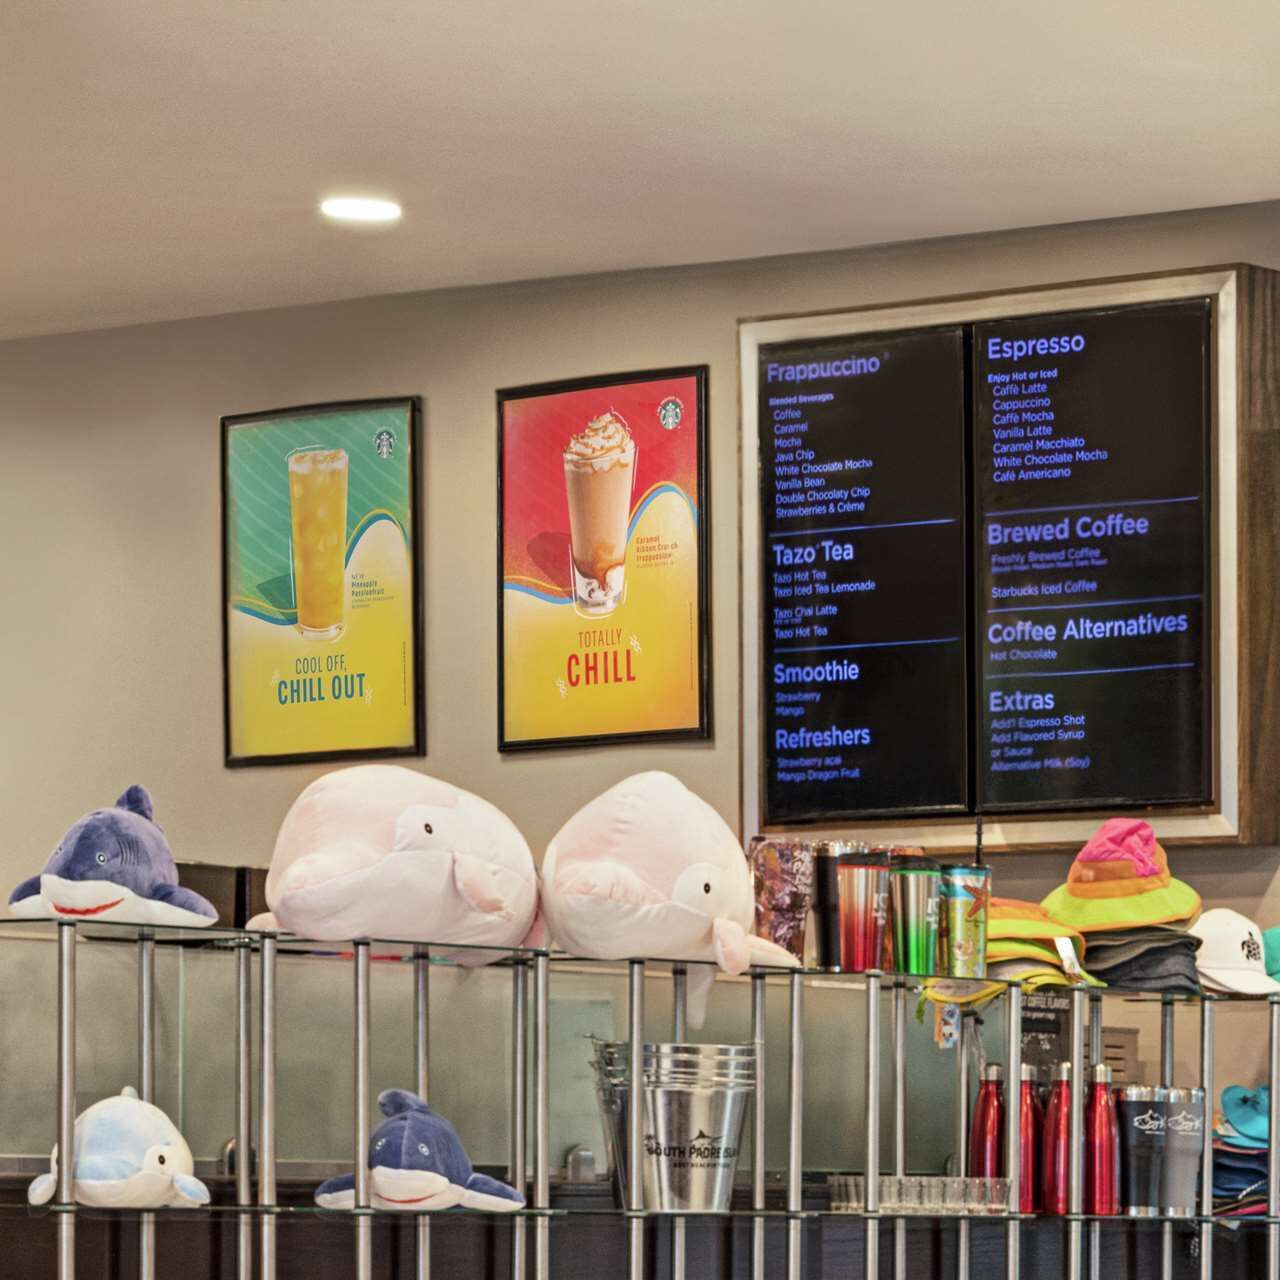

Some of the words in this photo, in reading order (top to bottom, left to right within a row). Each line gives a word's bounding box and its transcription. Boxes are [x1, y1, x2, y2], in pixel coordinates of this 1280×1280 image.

[988, 335, 1085, 361] Espresso
[767, 356, 880, 383] Frappuccino
[988, 374, 1010, 383] Enjoy
[1012, 372, 1027, 381] Hot
[1029, 371, 1037, 379] or
[1040, 369, 1058, 378] Iced
[1022, 383, 1047, 394] Latte
[993, 397, 1050, 411] Cappuccino
[774, 409, 801, 420] Coffee
[1022, 411, 1054, 422] Mocha
[774, 422, 808, 434] Caramel
[993, 427, 1024, 439] Vanilla
[1027, 426, 1052, 436] Latte
[775, 438, 801, 448] Mocha
[993, 441, 1033, 454] Caramel
[1036, 437, 1085, 450] Macchiato
[775, 452, 793, 462] Java
[796, 450, 815, 461] Chip
[993, 456, 1022, 467] White
[1024, 453, 1073, 466] Chocolate
[1076, 450, 1108, 461] Mocha
[775, 465, 799, 476] White
[802, 461, 842, 474] Chocolate
[845, 459, 872, 469] Mocha
[1018, 468, 1071, 480] Americano
[776, 479, 800, 490] Vanilla
[804, 477, 825, 487] Bean
[776, 493, 805, 504] Double
[807, 489, 849, 501] Chocolaty
[851, 487, 870, 497] Chip
[776, 504, 826, 518] Strawberries
[829, 503, 834, 513] &
[988, 517, 1069, 545] Brewed
[1076, 513, 1149, 537] Coffee
[773, 544, 816, 565] Tazo
[821, 540, 854, 561] Tea
[794, 571, 808, 581] Hot
[812, 570, 826, 580] Tea
[794, 585, 812, 595] Iced
[815, 583, 829, 593] Tea
[832, 580, 876, 593] Lemonade
[992, 586, 1039, 598] Starbucks
[1041, 582, 1062, 594] Iced
[1064, 580, 1098, 593] Coffee
[795, 607, 813, 617] Chai
[816, 605, 837, 615] Latte
[796, 627, 810, 637] Hot
[814, 626, 828, 636] Tea
[988, 621, 1056, 644] Coffee
[1063, 613, 1188, 640] Alternatives
[579, 628, 622, 648] TOTALLY
[295, 658, 323, 675] COOL
[326, 654, 347, 672] OFF,
[567, 649, 636, 687] CHILL
[774, 660, 859, 683] Smoothie
[277, 676, 325, 705] CHILL
[332, 672, 366, 700] OUT
[989, 691, 1054, 712] Extras
[1019, 718, 1061, 728] Espresso
[1063, 715, 1085, 725] Shot
[776, 725, 870, 749] Refreshers
[1013, 731, 1055, 740] Flavored
[1058, 730, 1084, 740] Syrup
